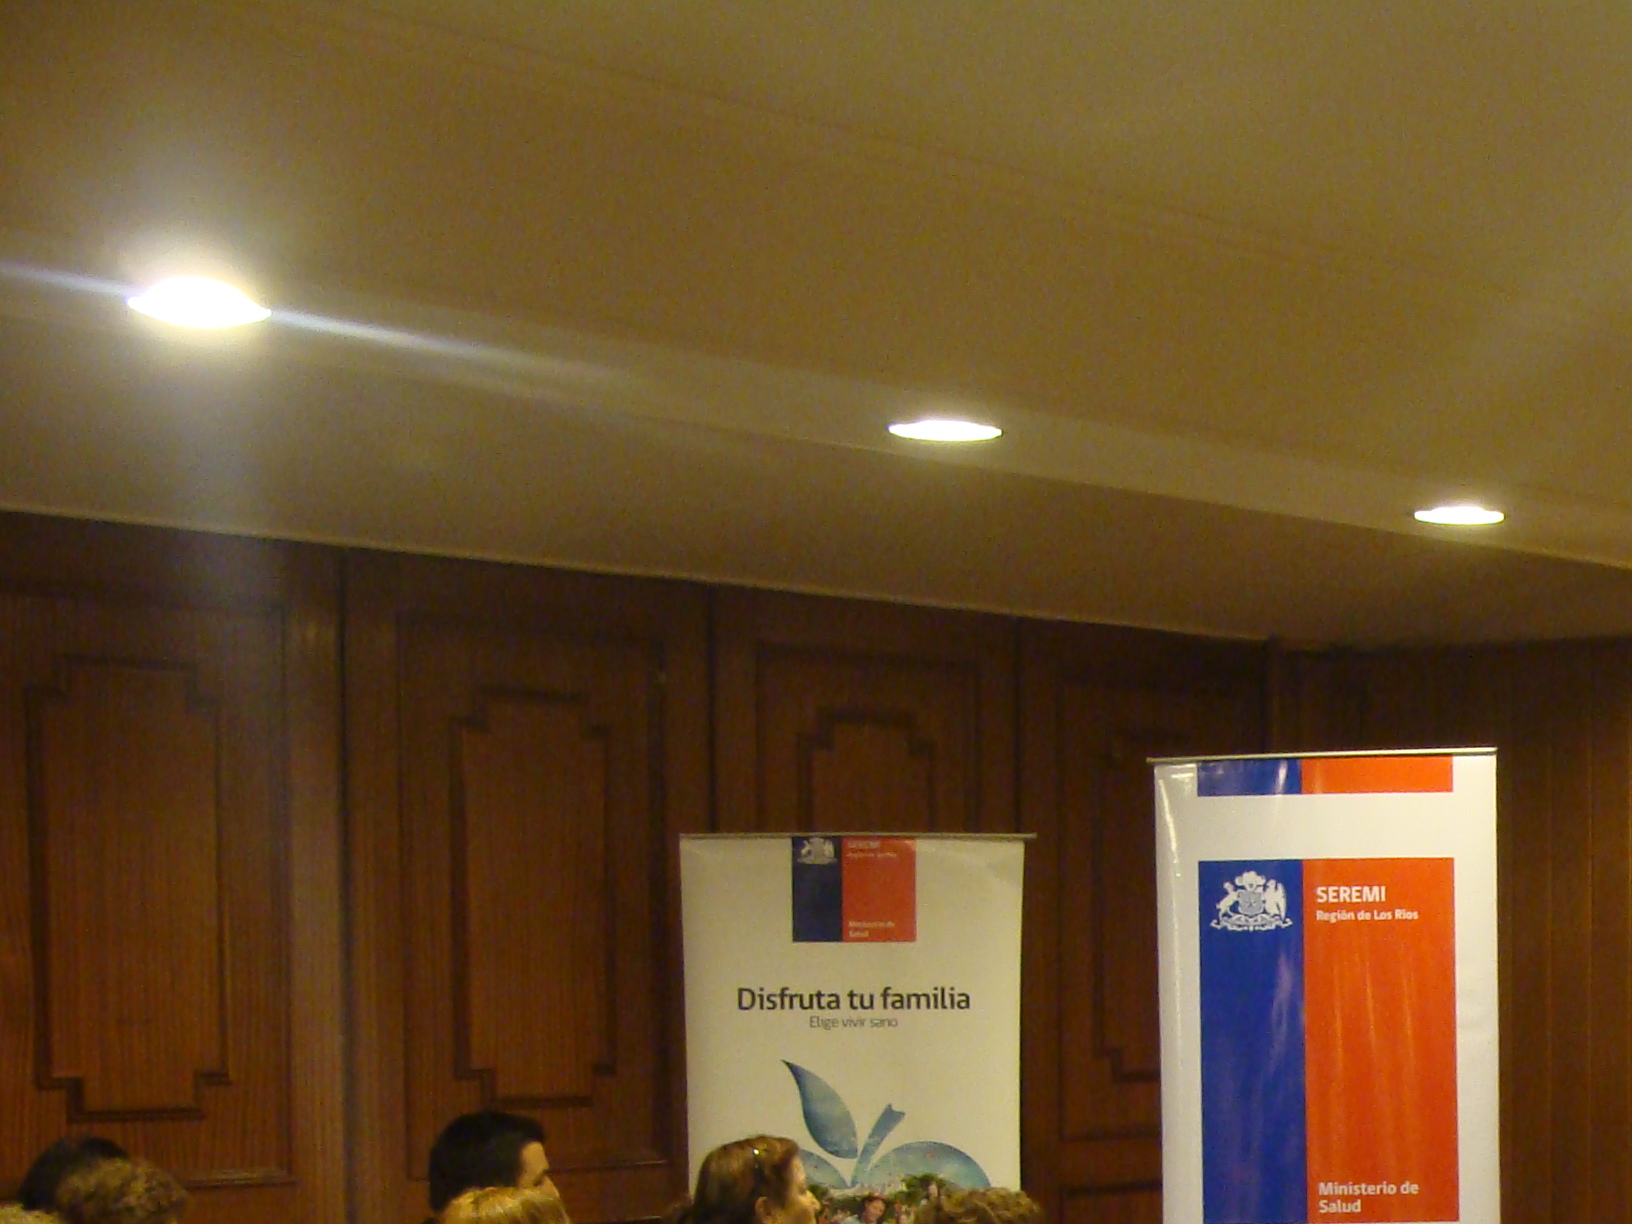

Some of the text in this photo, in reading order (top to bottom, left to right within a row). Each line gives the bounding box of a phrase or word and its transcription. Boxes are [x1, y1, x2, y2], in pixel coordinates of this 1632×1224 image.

[1316, 885, 1386, 903] SEREMI
[1316, 910, 1355, 923] Región
[1357, 909, 1371, 920] de
[1373, 909, 1392, 920] Los
[737, 986, 970, 1010] Disfruta tu familia
[809, 1015, 898, 1029] Elige vivir sano
[1318, 1181, 1419, 1196] Ministerio de
[1319, 1199, 1361, 1213] Salud
